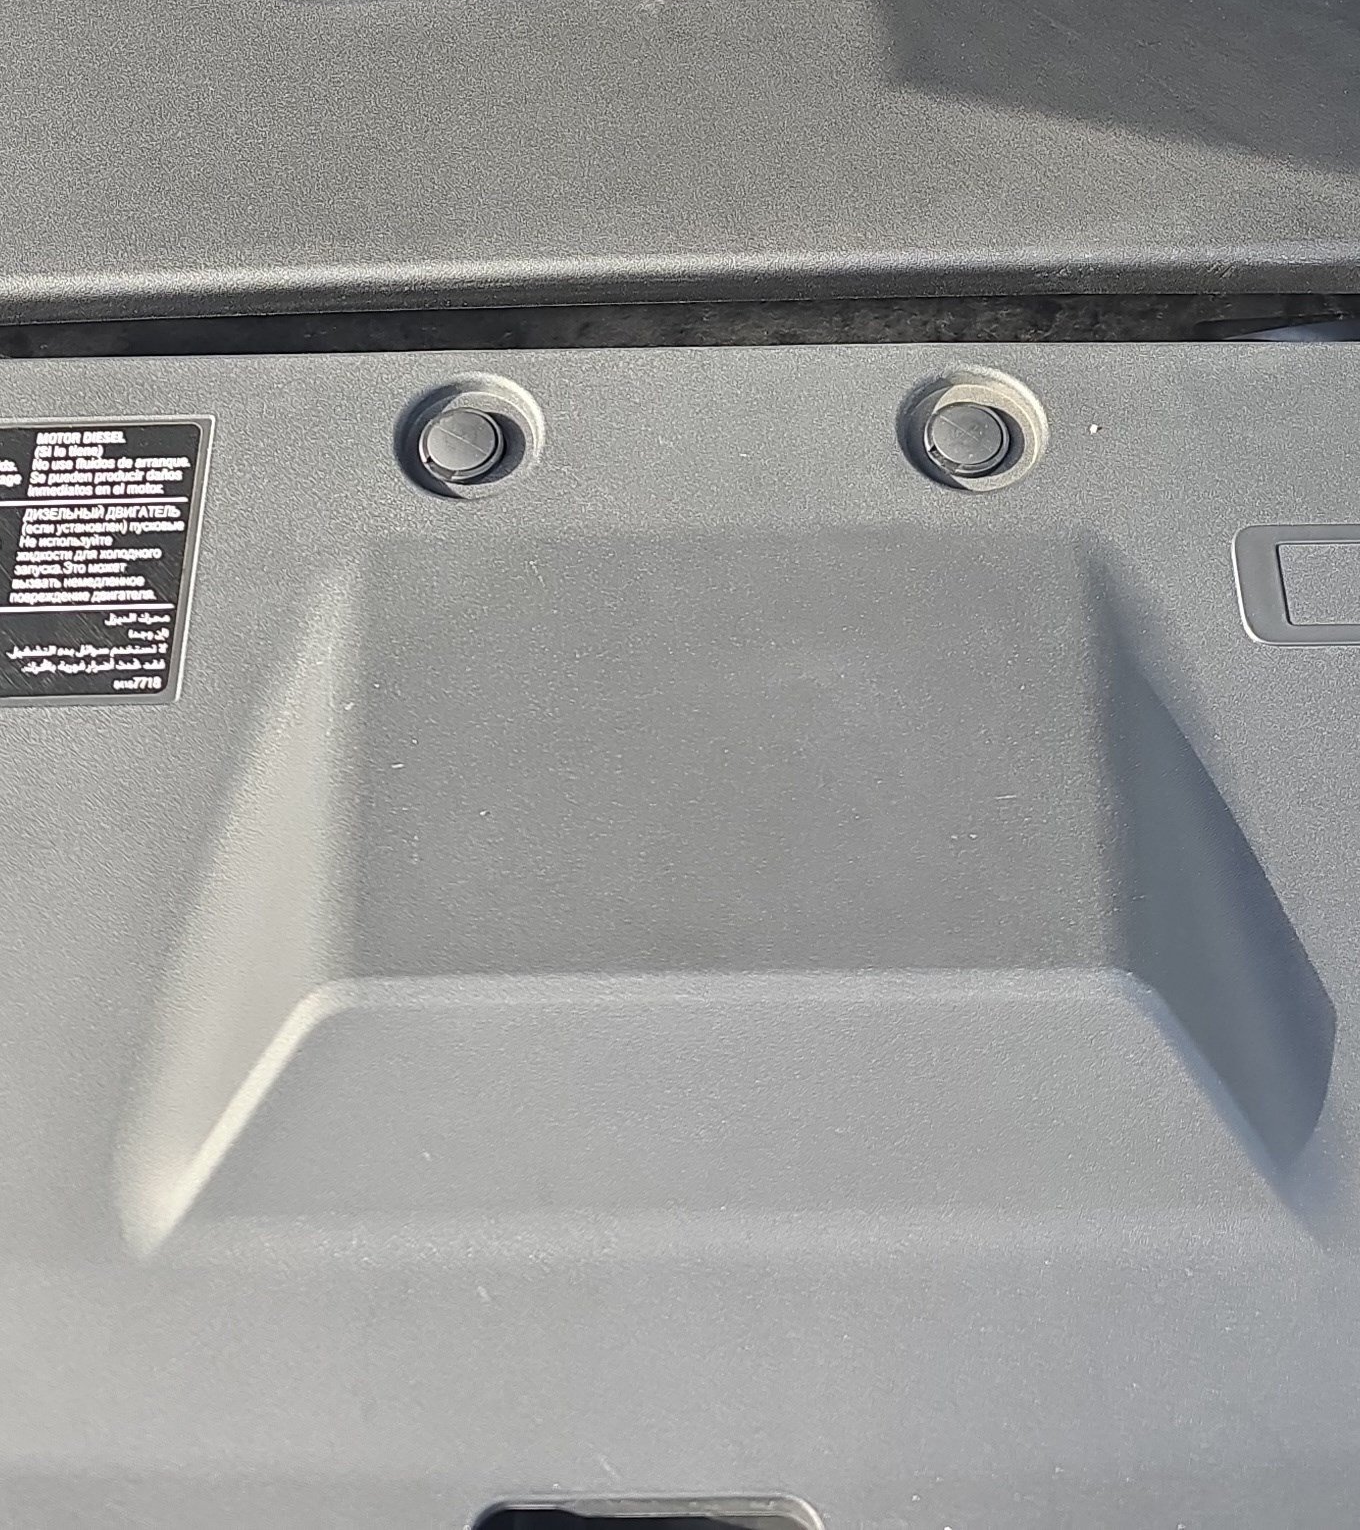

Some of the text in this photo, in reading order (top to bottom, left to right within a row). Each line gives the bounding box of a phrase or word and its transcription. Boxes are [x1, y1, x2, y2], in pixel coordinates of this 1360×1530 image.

[36, 431, 127, 445] MOTOR DIESEL
[34, 445, 51, 459] (Si
[68, 444, 104, 458] tiene)
[31, 456, 191, 471] No use fluidos de arranque.
[29, 468, 183, 485] Se pueden producir daños
[95, 484, 111, 496] en
[113, 483, 125, 495] el
[126, 483, 165, 496] motor.
[23, 504, 181, 522] ДИЗЕЛЬНЫЙ ДВИГАТЕЛЬ
[56, 519, 128, 536] установлен)
[129, 520, 186, 535] пусковые
[19, 533, 113, 549] Не используйте
[74, 549, 98, 562] для
[99, 548, 163, 561] холодного
